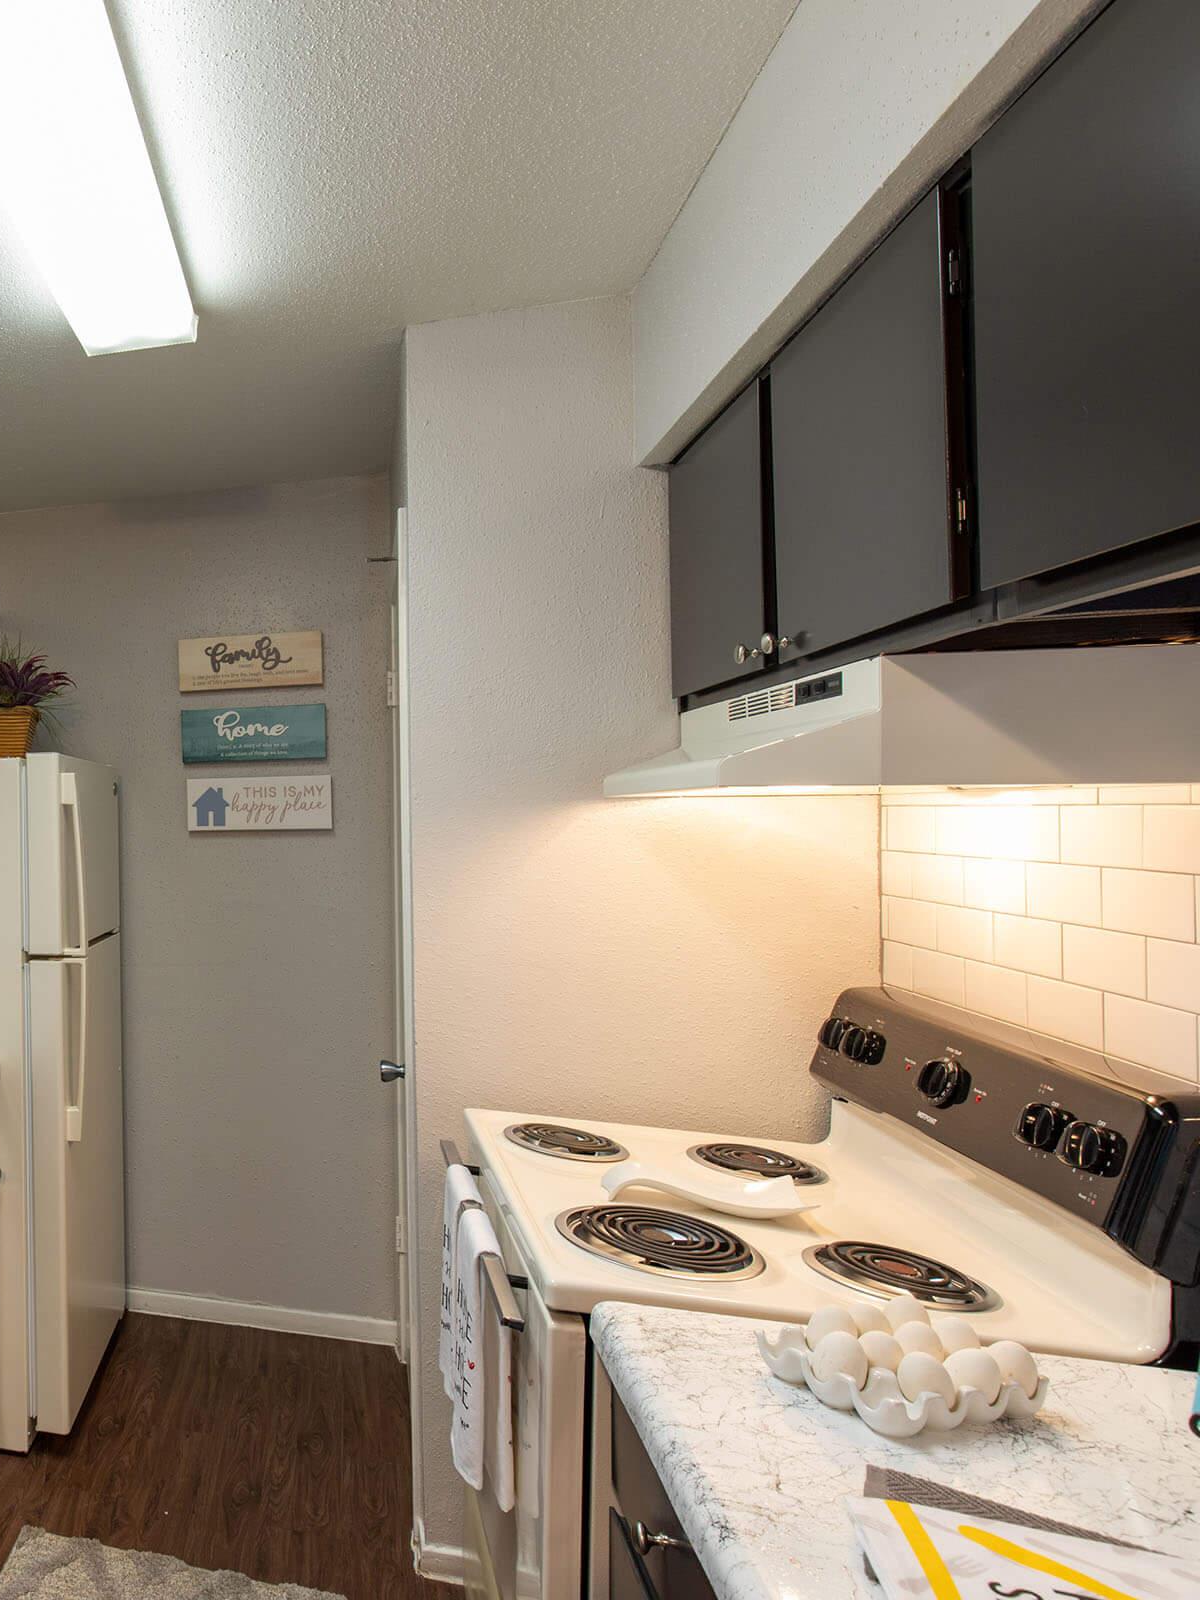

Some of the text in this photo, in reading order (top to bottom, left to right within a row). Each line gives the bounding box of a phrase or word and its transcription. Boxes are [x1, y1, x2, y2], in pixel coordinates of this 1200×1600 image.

[204, 636, 293, 673] family
[213, 711, 289, 741] home
[243, 785, 325, 798] THIS IS MY
[231, 791, 279, 824] happy
